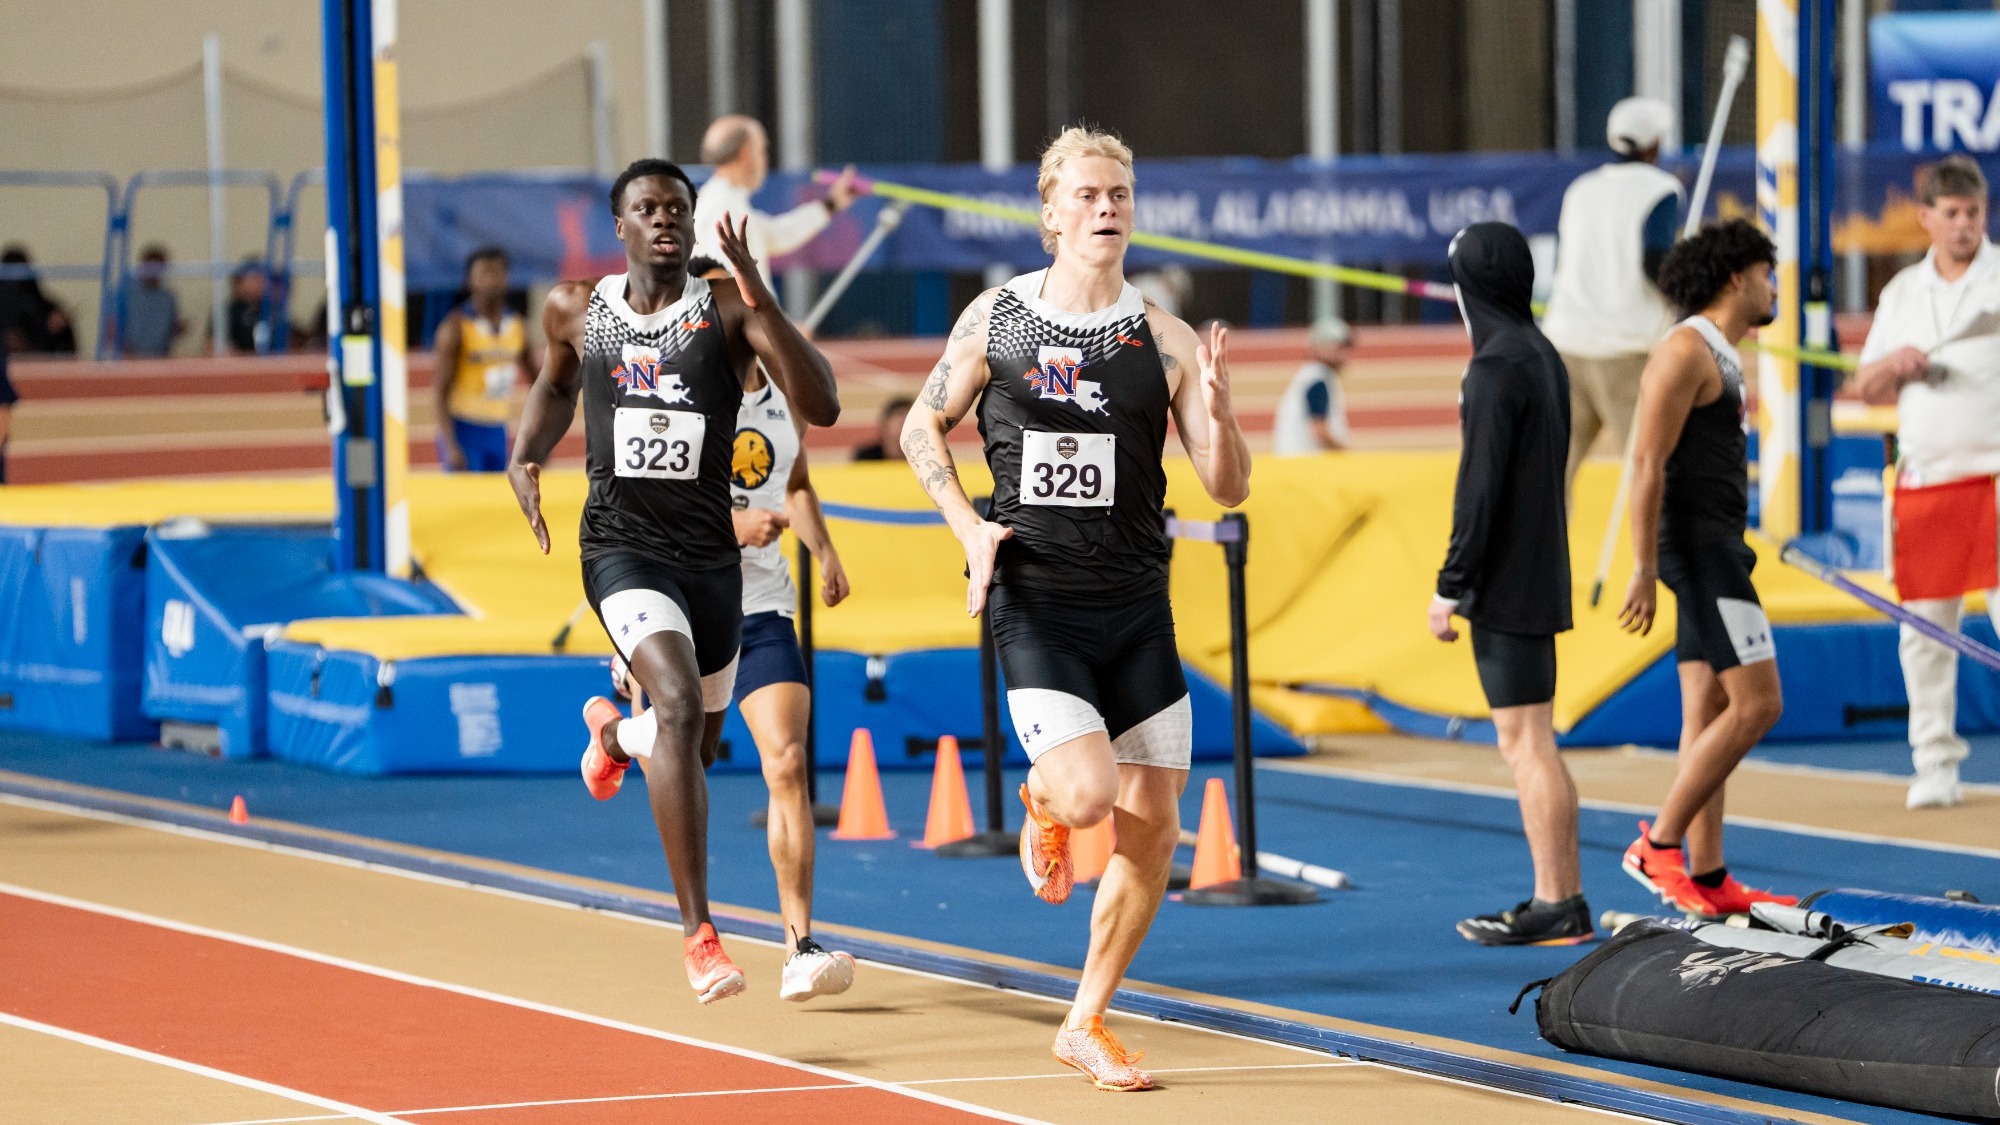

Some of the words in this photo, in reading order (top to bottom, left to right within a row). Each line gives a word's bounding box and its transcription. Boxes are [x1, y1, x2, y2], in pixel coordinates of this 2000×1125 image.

[629, 361, 658, 391] N
[1044, 363, 1077, 397] N
[625, 437, 690, 472] 323
[1032, 462, 1102, 499] 329
